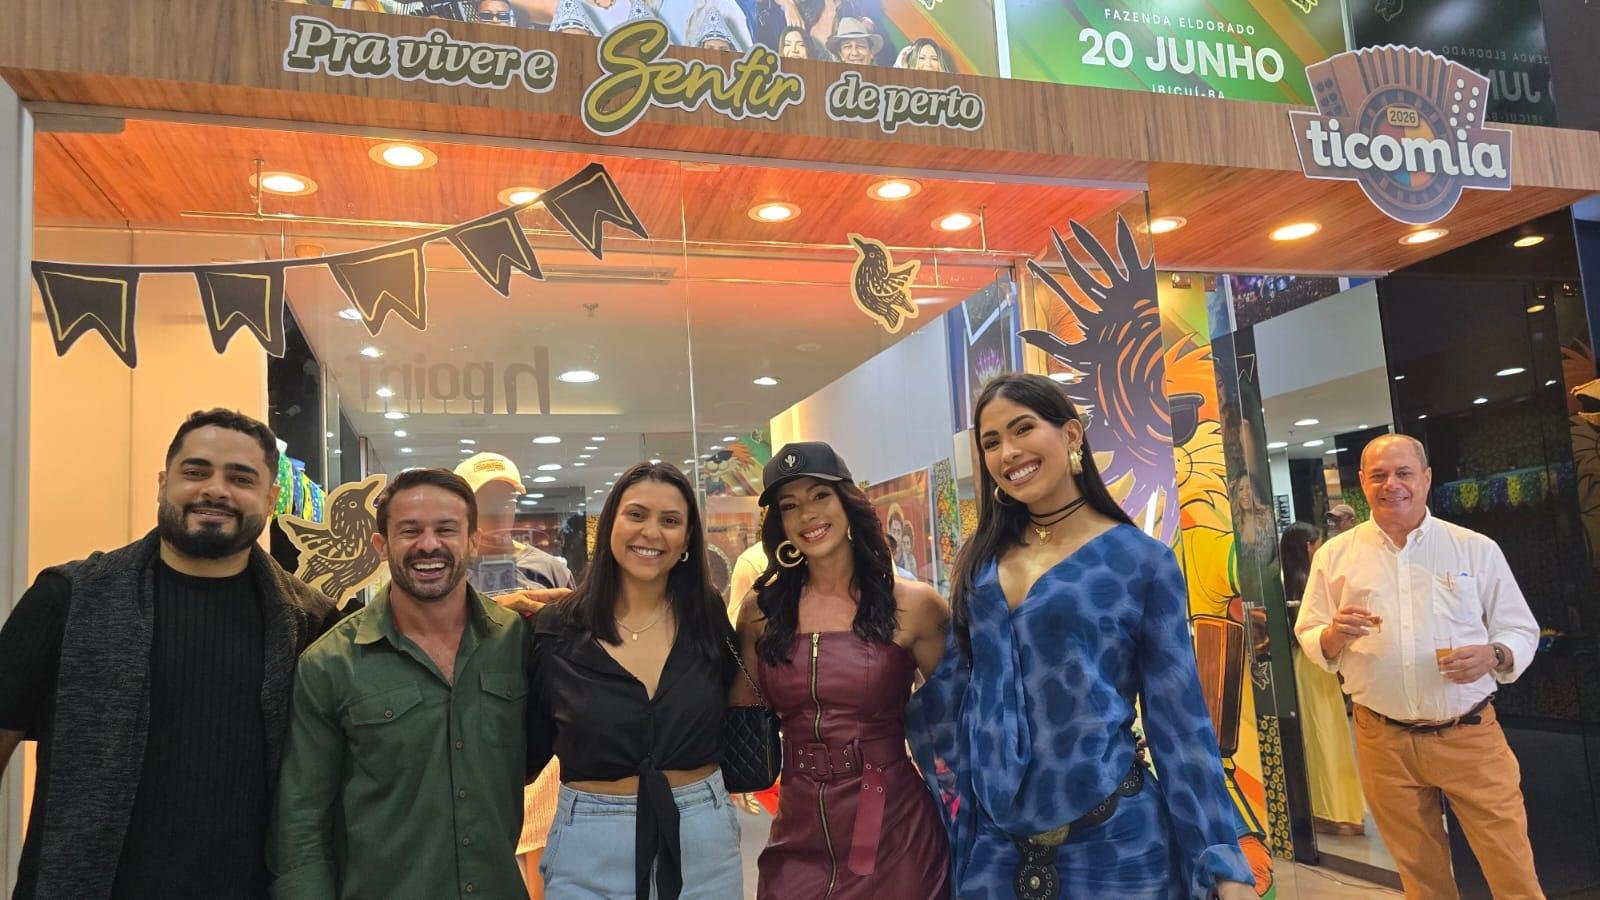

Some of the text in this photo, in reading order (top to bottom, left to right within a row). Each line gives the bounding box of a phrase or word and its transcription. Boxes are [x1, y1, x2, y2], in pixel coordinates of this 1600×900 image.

[1104, 8, 1256, 36] FAZENDA ELDORADO
[287, 18, 983, 132] Pra viver e Sentir de perto
[1078, 27, 1286, 83] 20 JUNHO
[1389, 109, 1417, 124] 2026
[1305, 118, 1507, 179] ticomia
